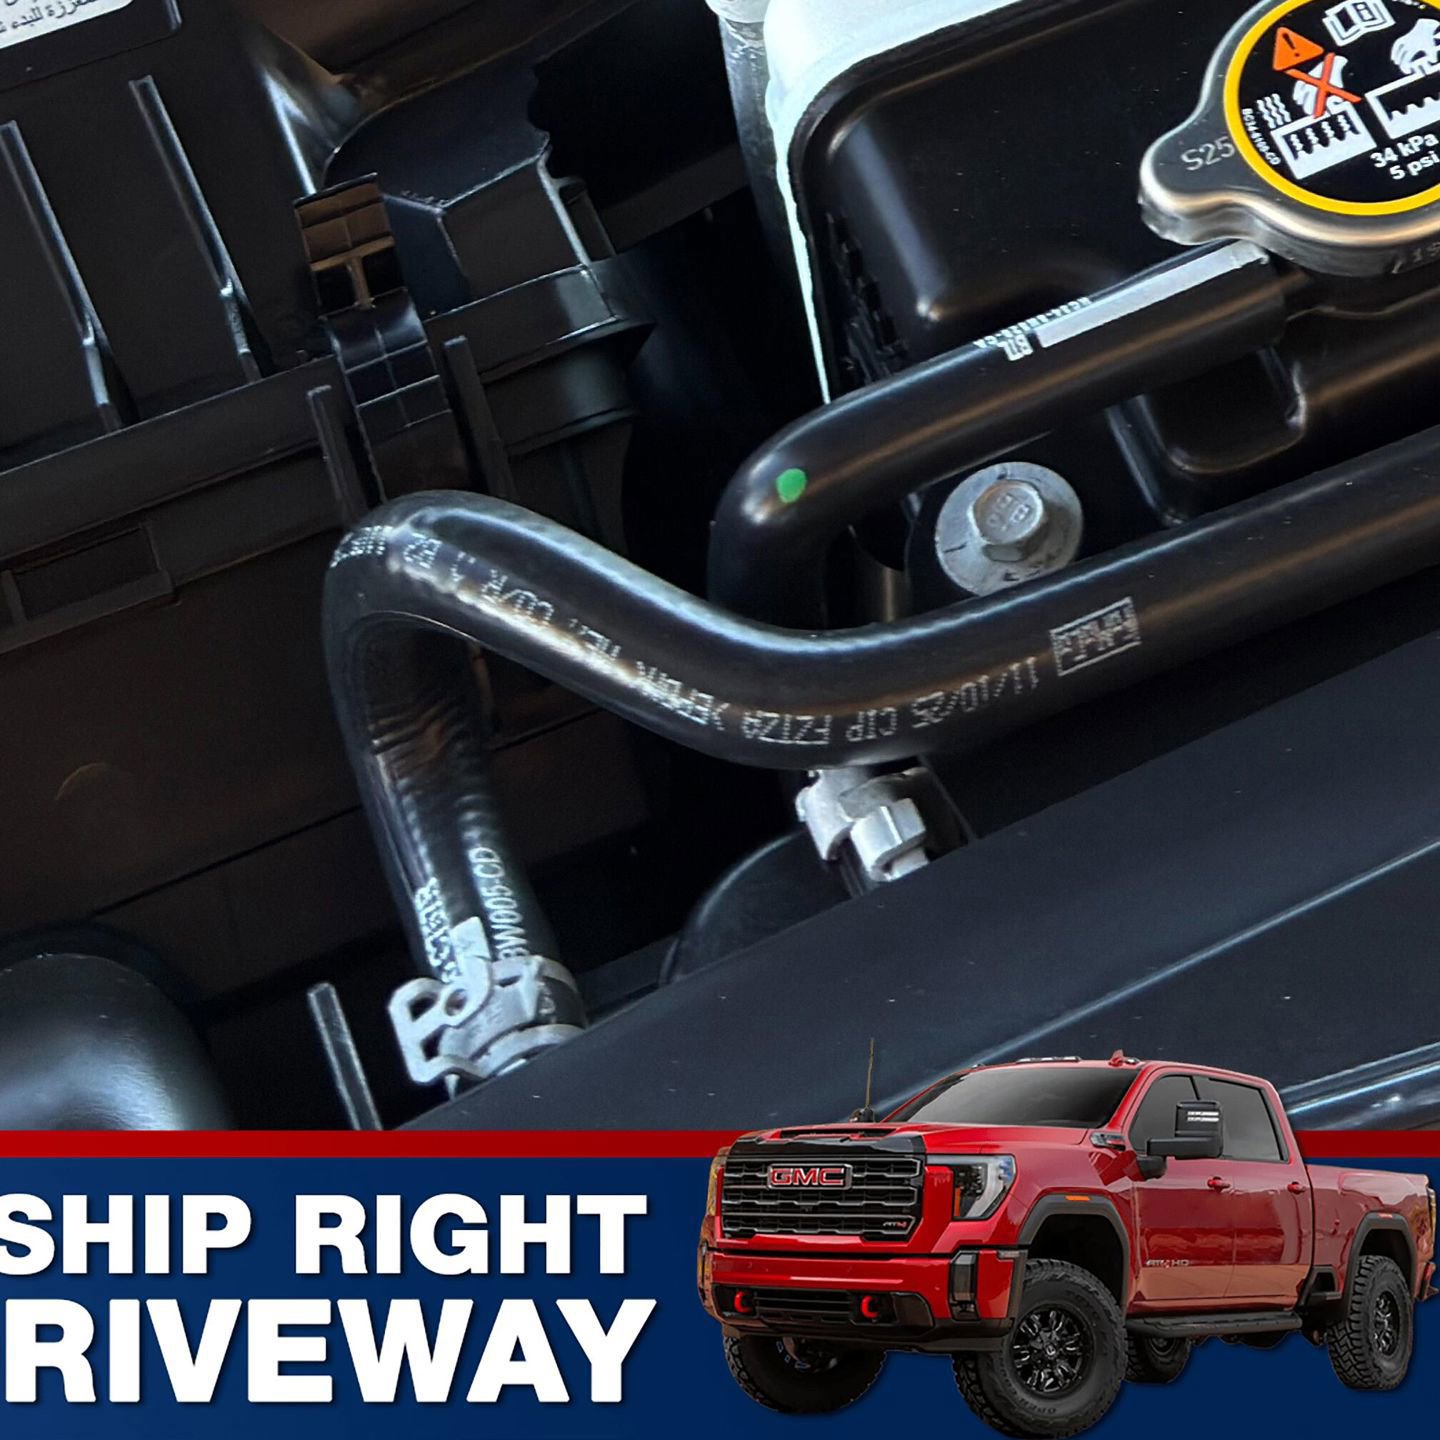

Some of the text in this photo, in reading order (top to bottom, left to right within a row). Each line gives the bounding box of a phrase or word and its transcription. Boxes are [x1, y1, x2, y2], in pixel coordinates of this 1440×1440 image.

[1370, 132, 1440, 168] 34 kPa
[1389, 150, 1440, 180] 5 psi
